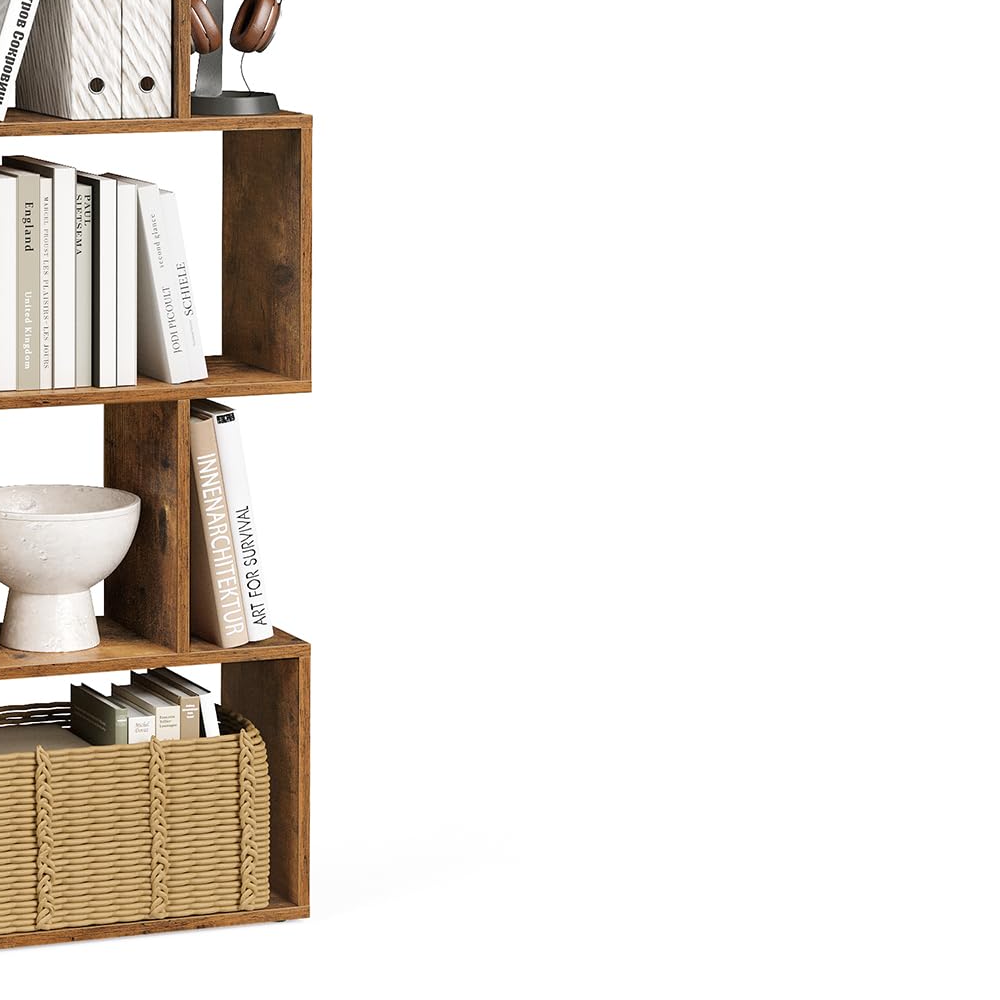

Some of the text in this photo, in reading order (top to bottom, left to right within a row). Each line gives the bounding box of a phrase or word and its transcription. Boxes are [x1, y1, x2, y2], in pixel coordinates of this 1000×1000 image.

[22, 202, 34, 252] England
[162, 286, 183, 354] JODI PICOULT
[176, 262, 194, 316] SCHIELE
[23, 291, 32, 369] United Kingdom
[197, 452, 244, 636] INNENARCHITEKTUR
[236, 505, 267, 626] ART FOR SURVIVAL
